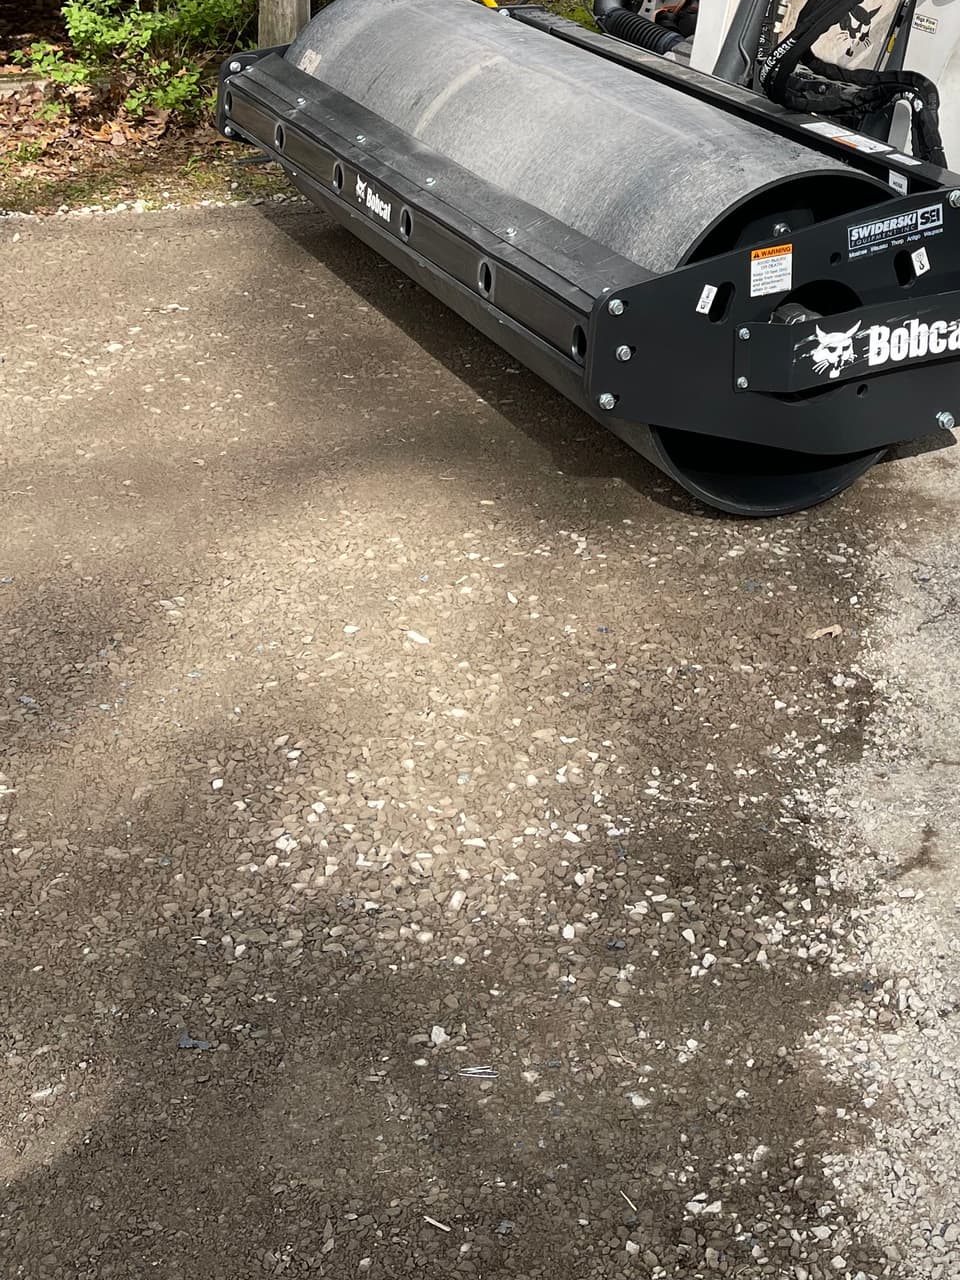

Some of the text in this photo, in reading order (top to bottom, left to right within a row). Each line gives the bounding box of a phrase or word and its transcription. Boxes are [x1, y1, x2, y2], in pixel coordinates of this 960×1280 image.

[366, 187, 391, 223] Bobcat
[850, 207, 940, 241] SWIDERSKI SEI
[851, 228, 899, 247] EQUIPMENT
[761, 247, 791, 257] WARNING
